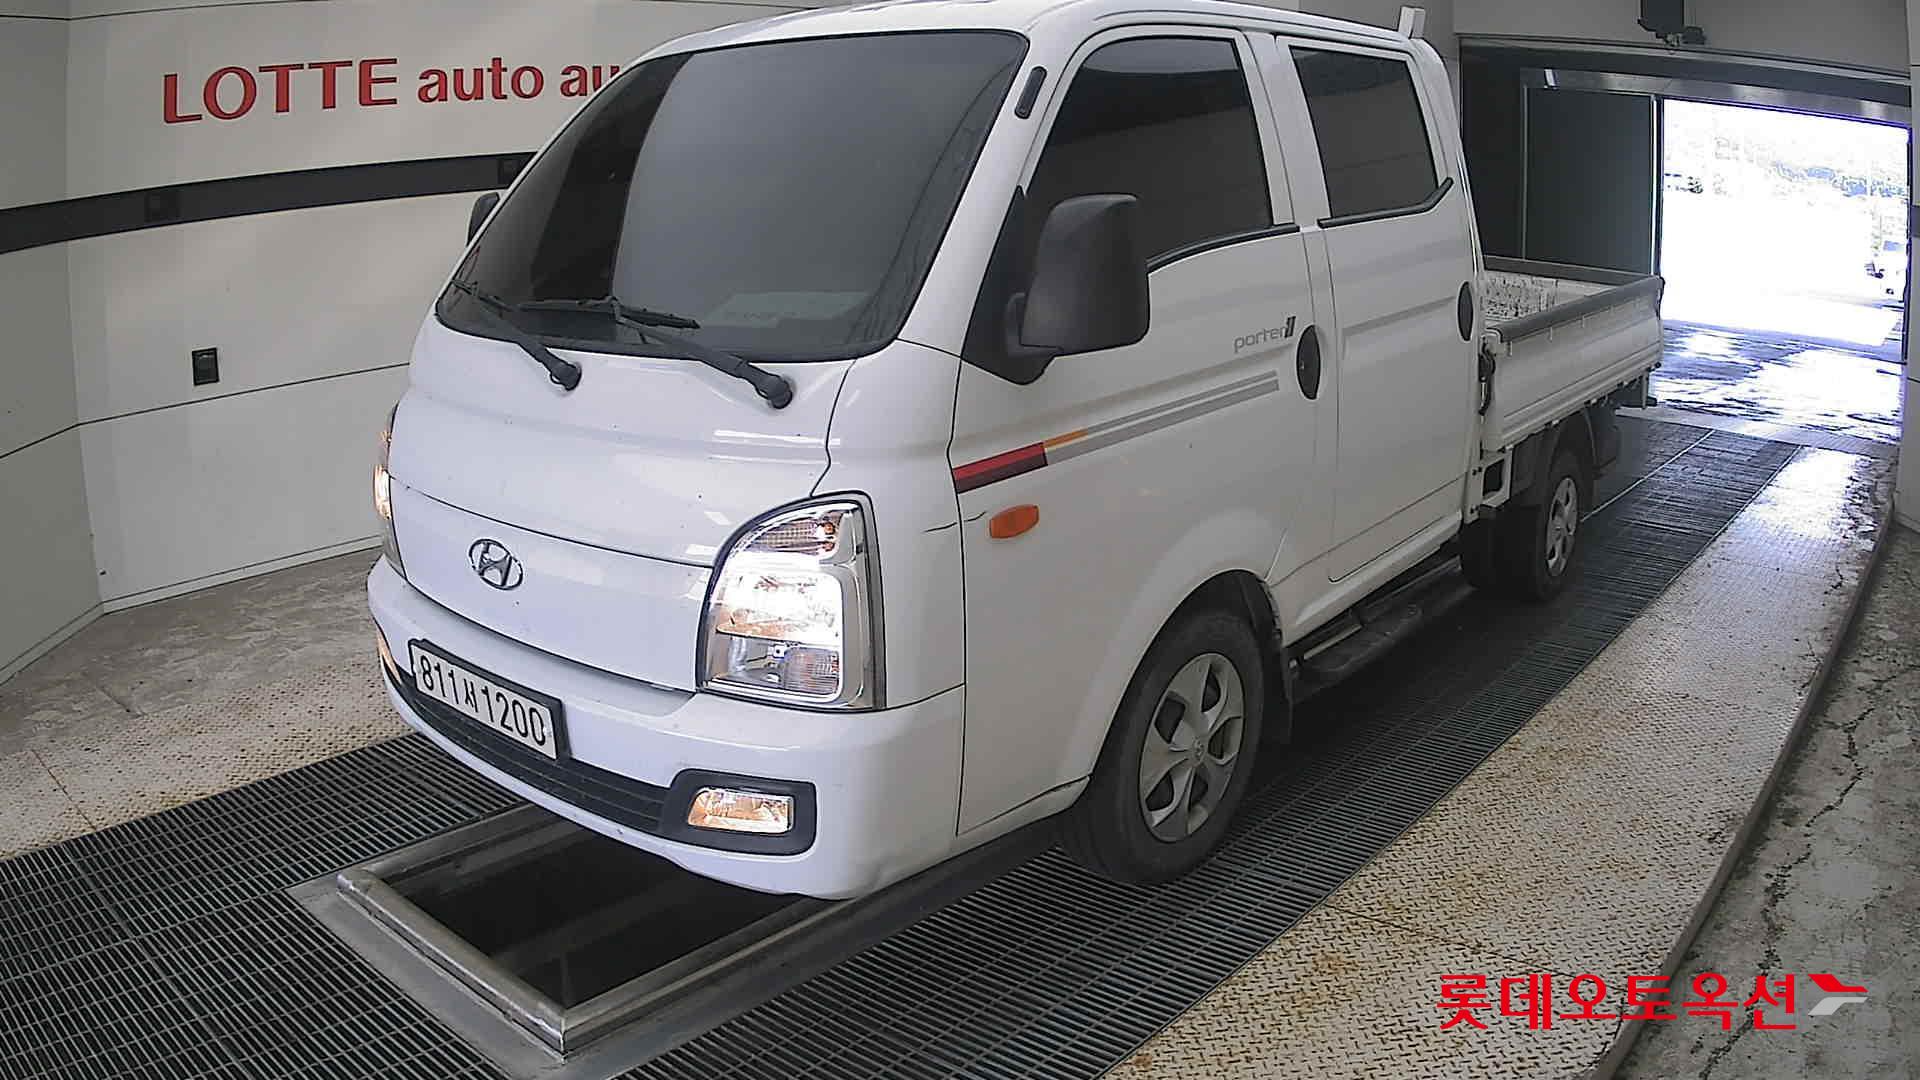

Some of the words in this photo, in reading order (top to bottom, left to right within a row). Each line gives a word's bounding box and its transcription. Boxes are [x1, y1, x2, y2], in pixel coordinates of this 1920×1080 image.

[164, 57, 398, 124] LOTTE
[418, 57, 544, 103] auto
[420, 655, 546, 746] 811서1200
